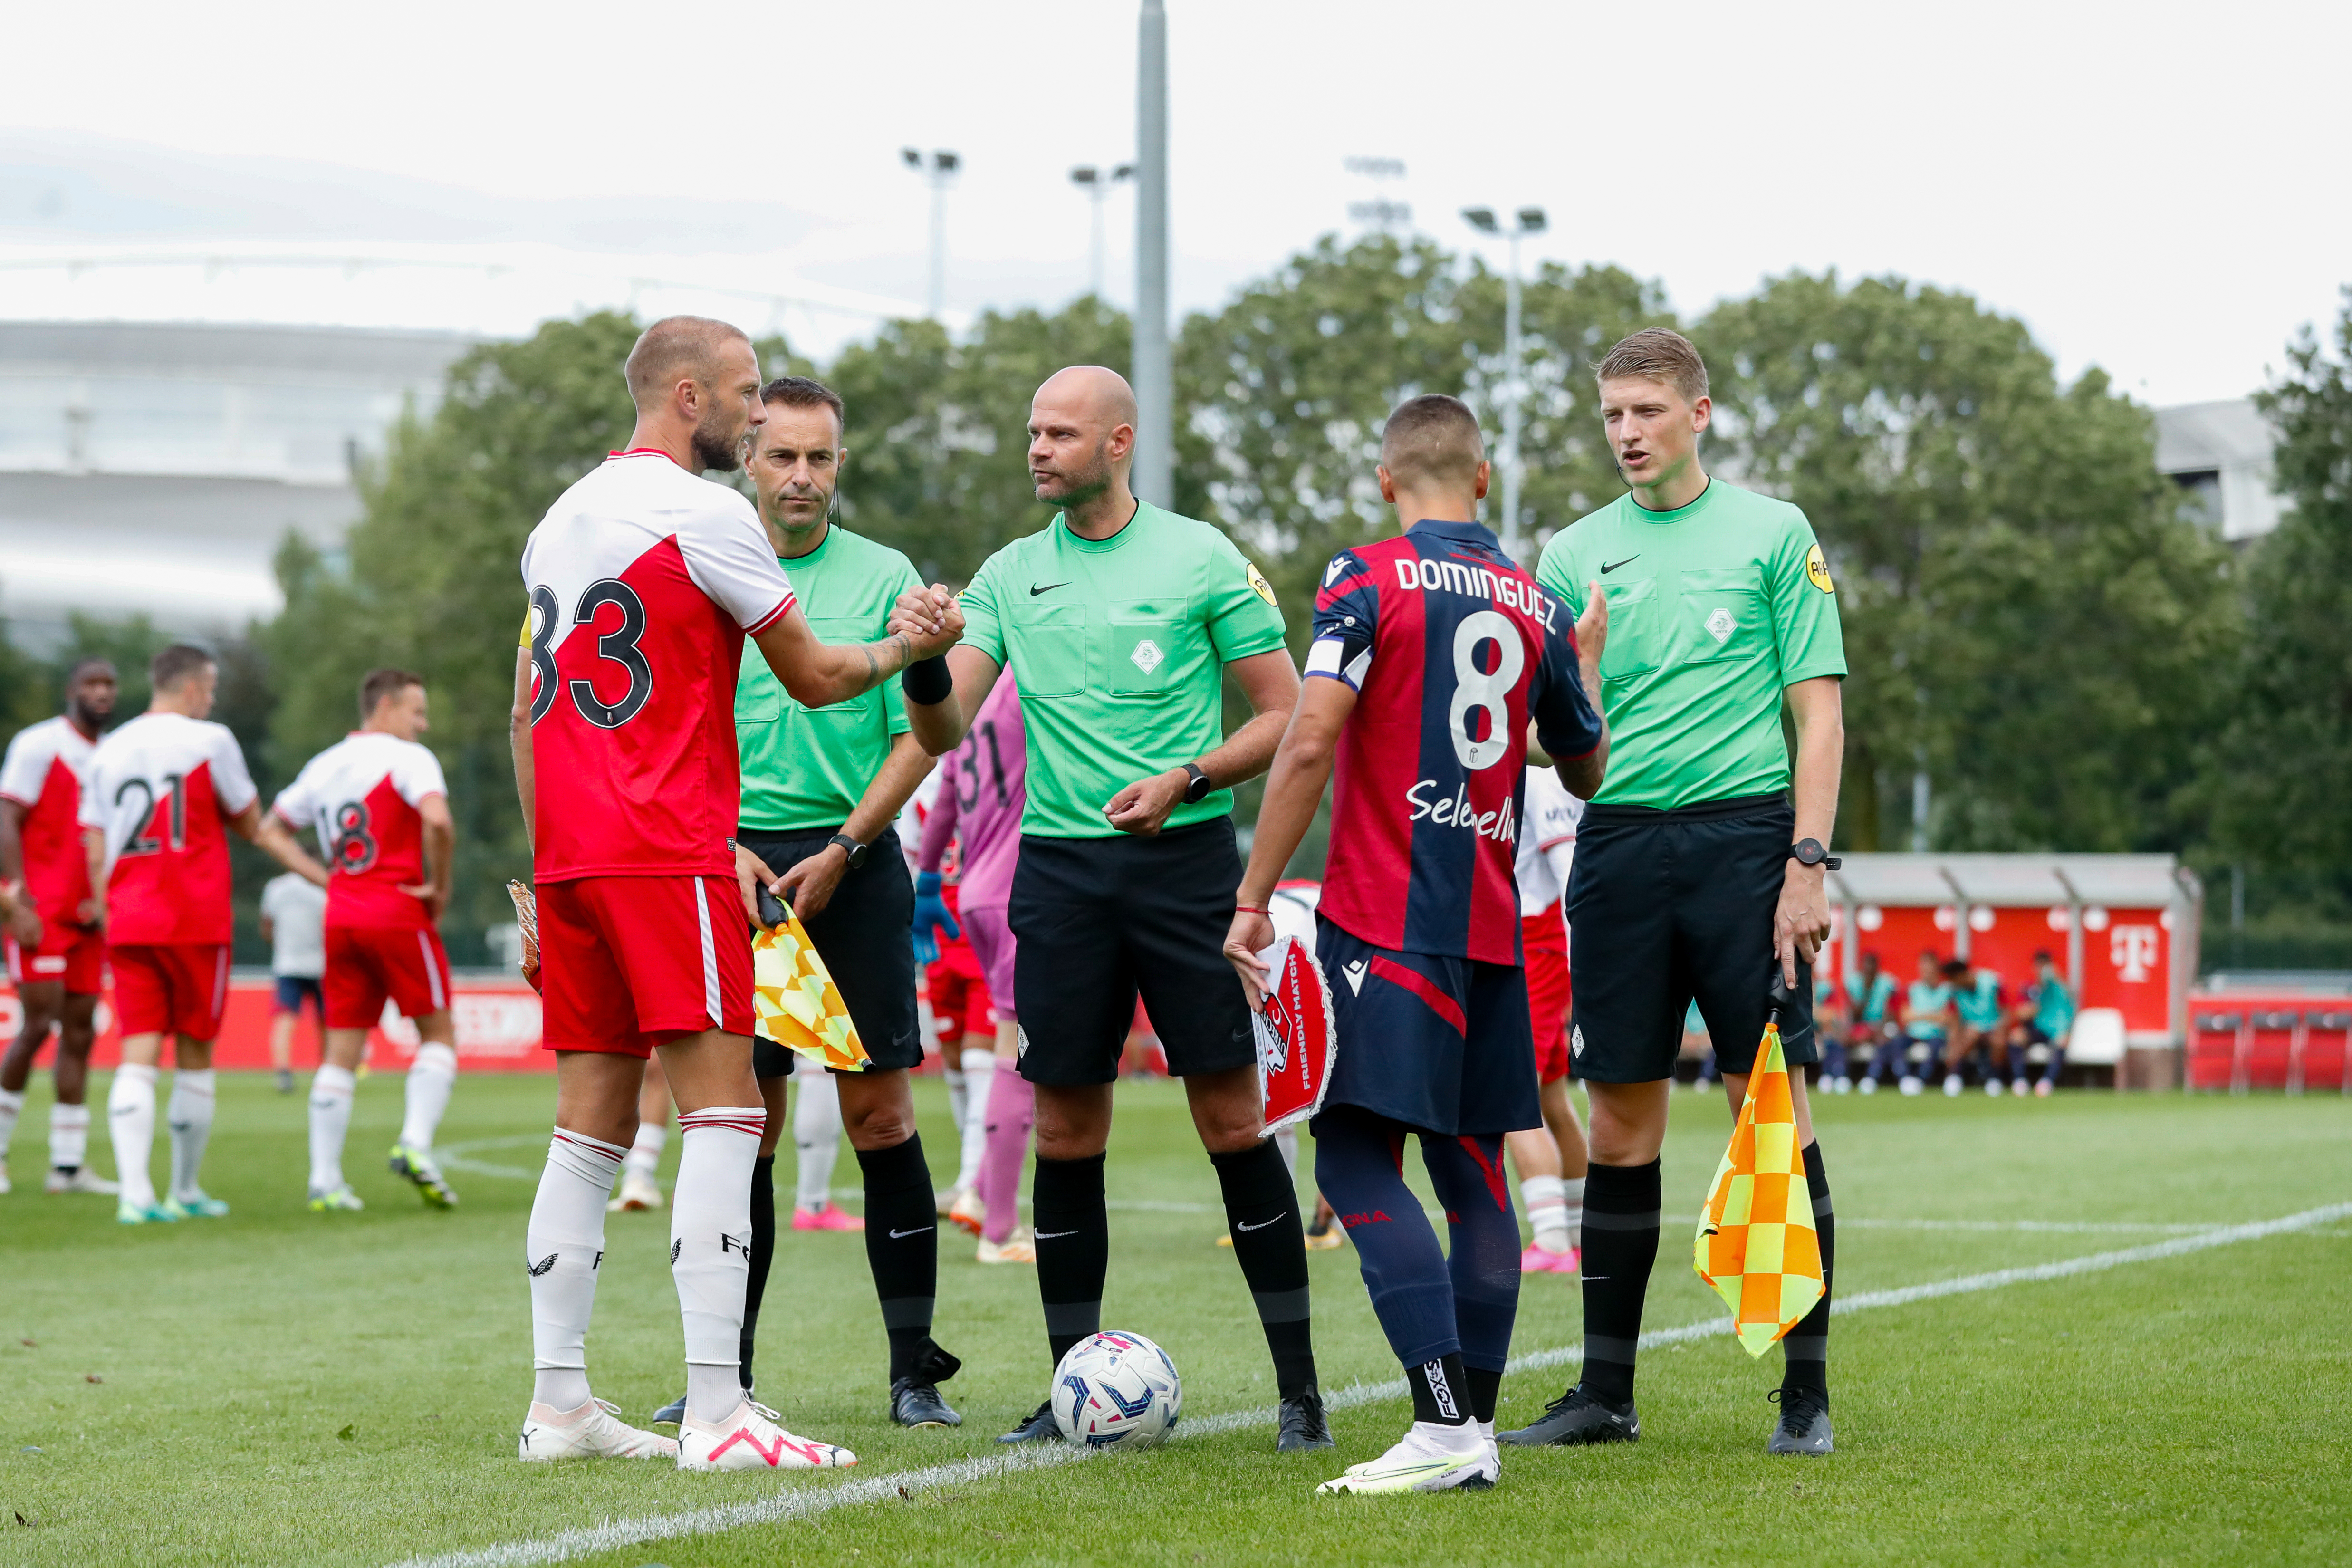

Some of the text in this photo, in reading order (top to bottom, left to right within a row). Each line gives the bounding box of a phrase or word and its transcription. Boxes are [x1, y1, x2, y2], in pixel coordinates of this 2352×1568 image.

[1394, 559, 1556, 635] DOMINGUEZ
[1450, 610, 1524, 770] 8
[955, 721, 1010, 813] 31
[115, 774, 186, 859] 21
[317, 801, 379, 875] 18
[1406, 780, 1515, 844] Selenella
[1272, 1008, 1281, 1025] C
[1289, 954, 1311, 1090] FRIENDLY MATCH
[1341, 1210, 1392, 1228] GNA
